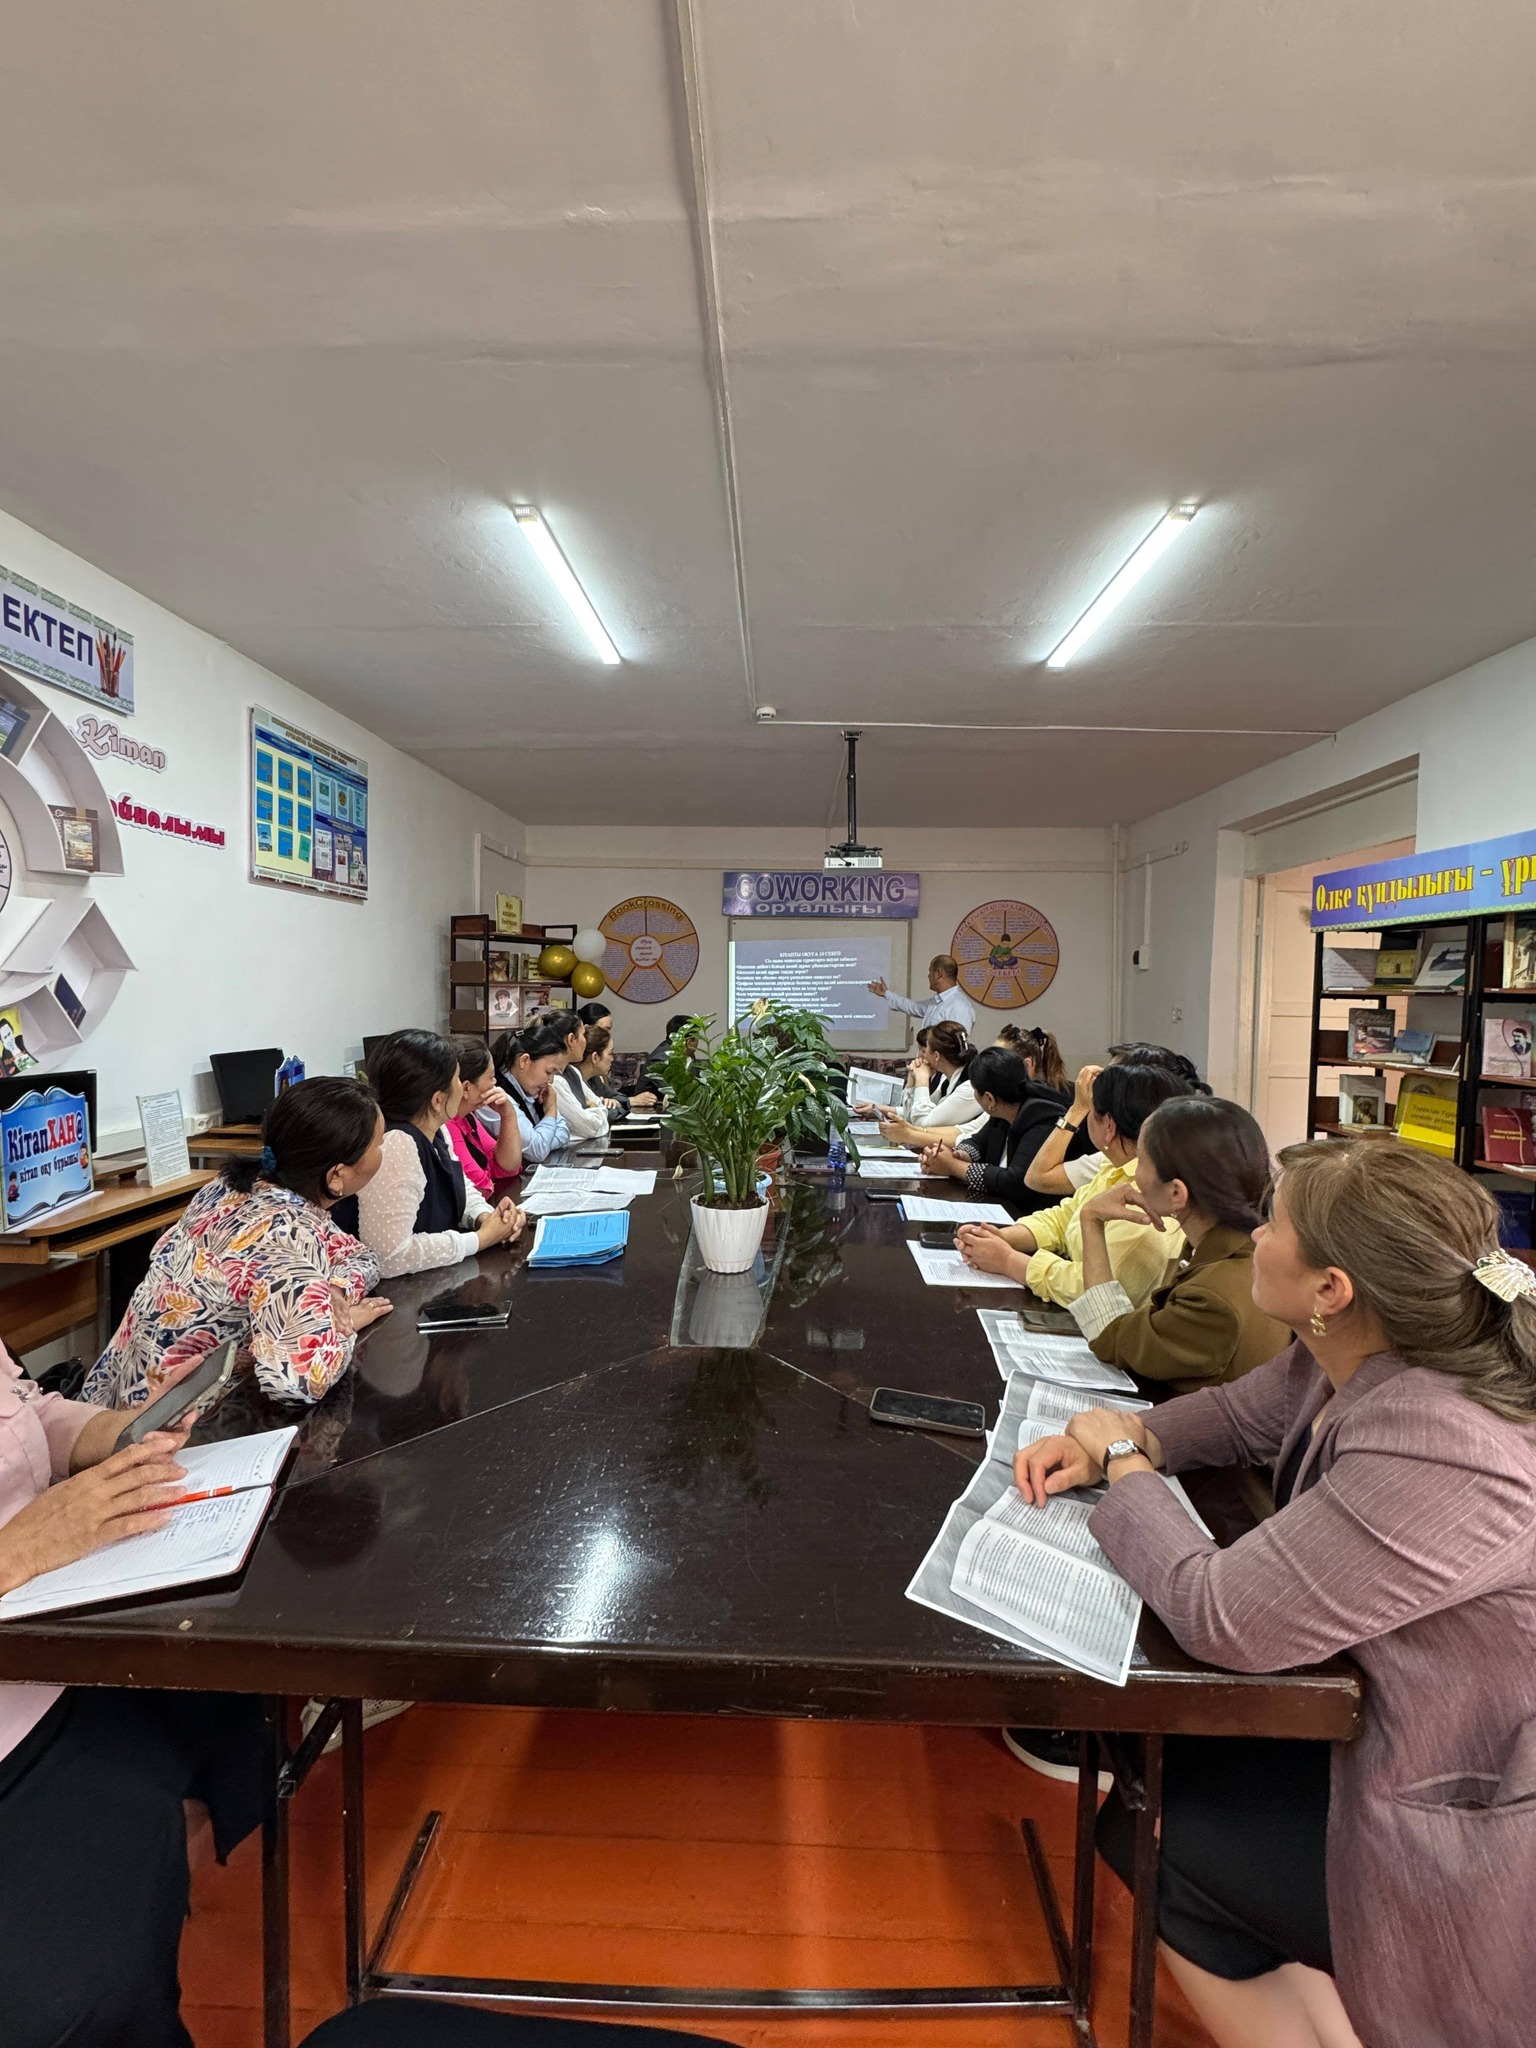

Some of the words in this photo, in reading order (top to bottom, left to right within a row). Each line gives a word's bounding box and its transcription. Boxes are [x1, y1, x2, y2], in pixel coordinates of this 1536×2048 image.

[70, 718, 166, 769] Кітап
[735, 874, 906, 903] COWORKING
[1315, 884, 1352, 912] Өлке
[608, 899, 684, 921] BookCrossing
[755, 903, 882, 915] орталығы
[20, 1165, 38, 1183] кітап
